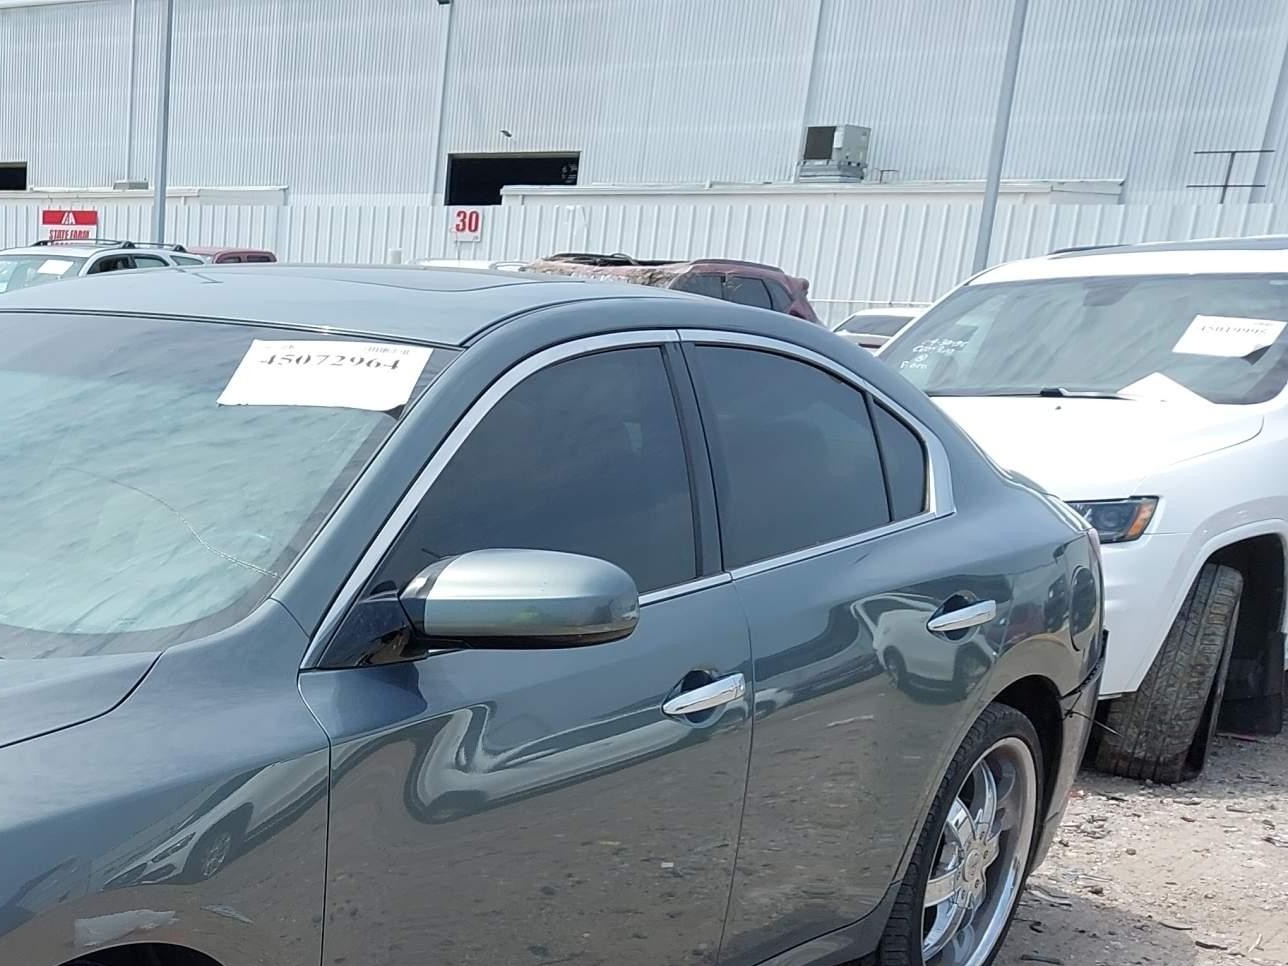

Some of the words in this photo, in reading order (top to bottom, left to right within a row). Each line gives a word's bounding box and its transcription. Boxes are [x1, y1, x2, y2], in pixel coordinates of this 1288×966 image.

[455, 210, 479, 232] 30
[49, 229, 69, 241] STATE
[70, 229, 90, 240] FARM
[259, 353, 400, 370] 45072964
